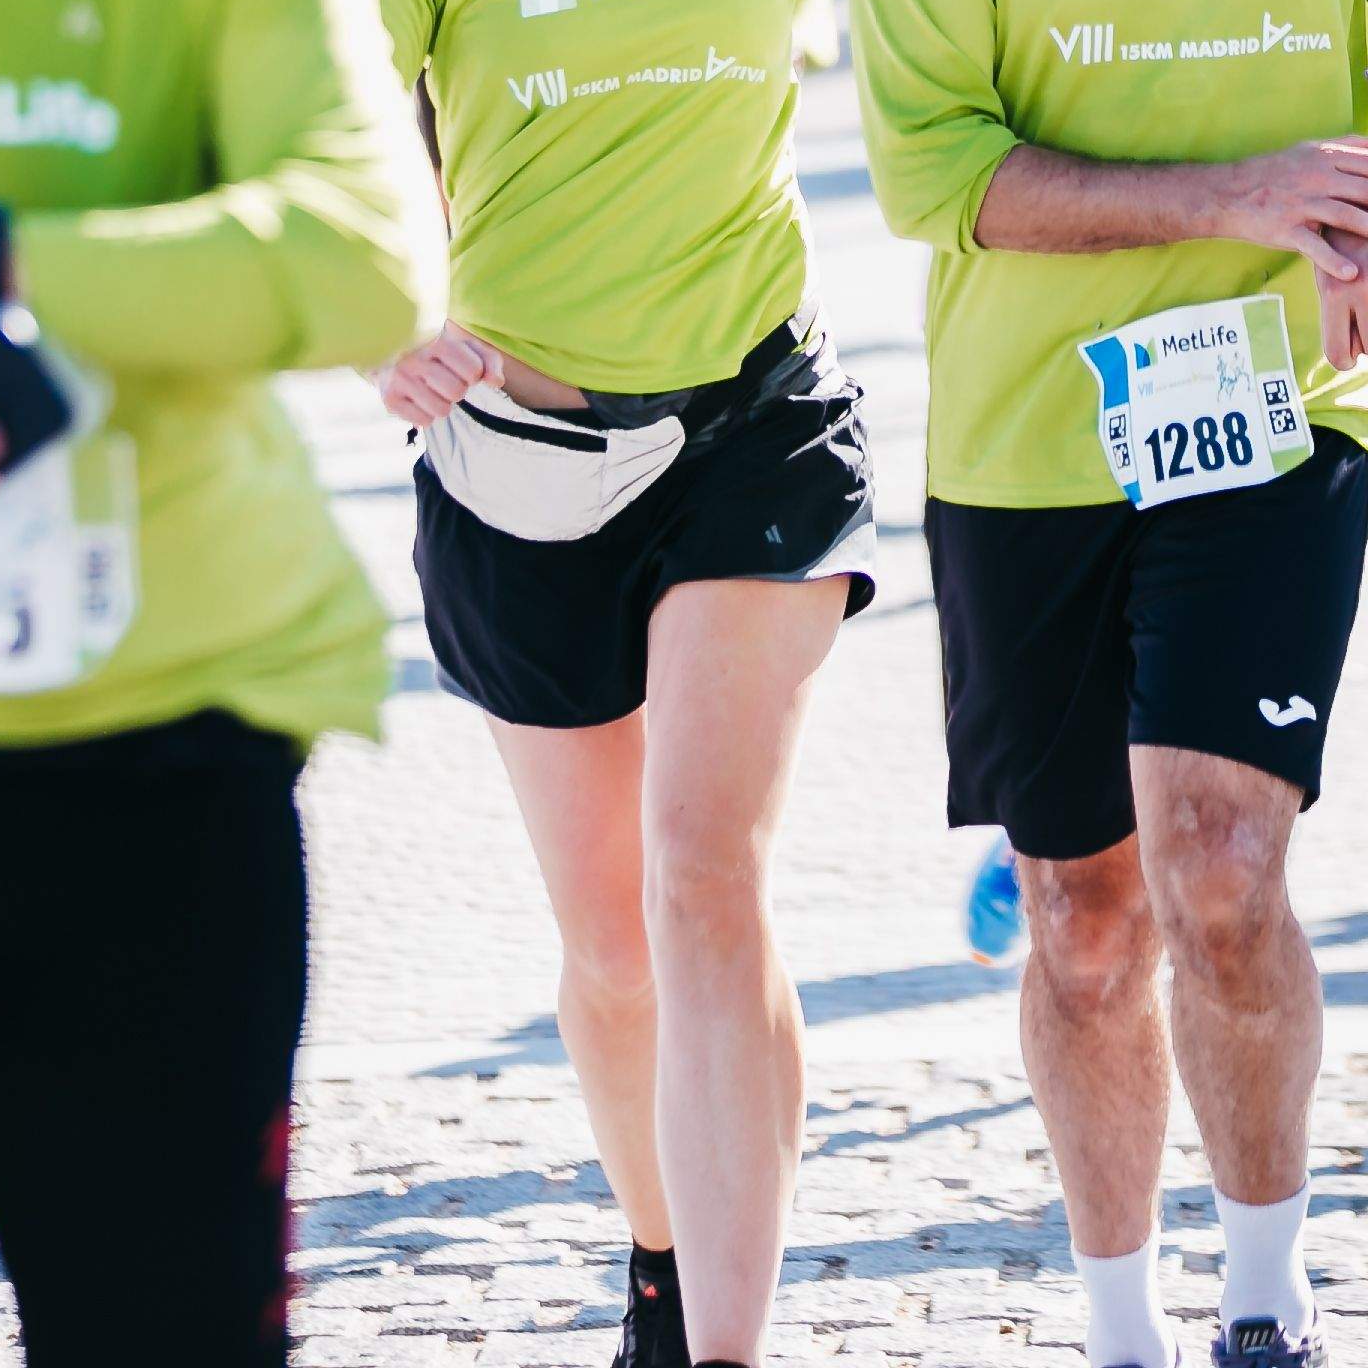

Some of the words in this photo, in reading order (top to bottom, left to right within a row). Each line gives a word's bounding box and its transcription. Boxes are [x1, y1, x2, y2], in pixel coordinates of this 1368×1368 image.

[1048, 23, 1114, 64] VIII
[1120, 41, 1173, 61] 15KM
[507, 67, 568, 111] VIII
[572, 76, 621, 98] 15KM
[1162, 325, 1239, 358] MetLife
[1144, 411, 1255, 484] 1288
